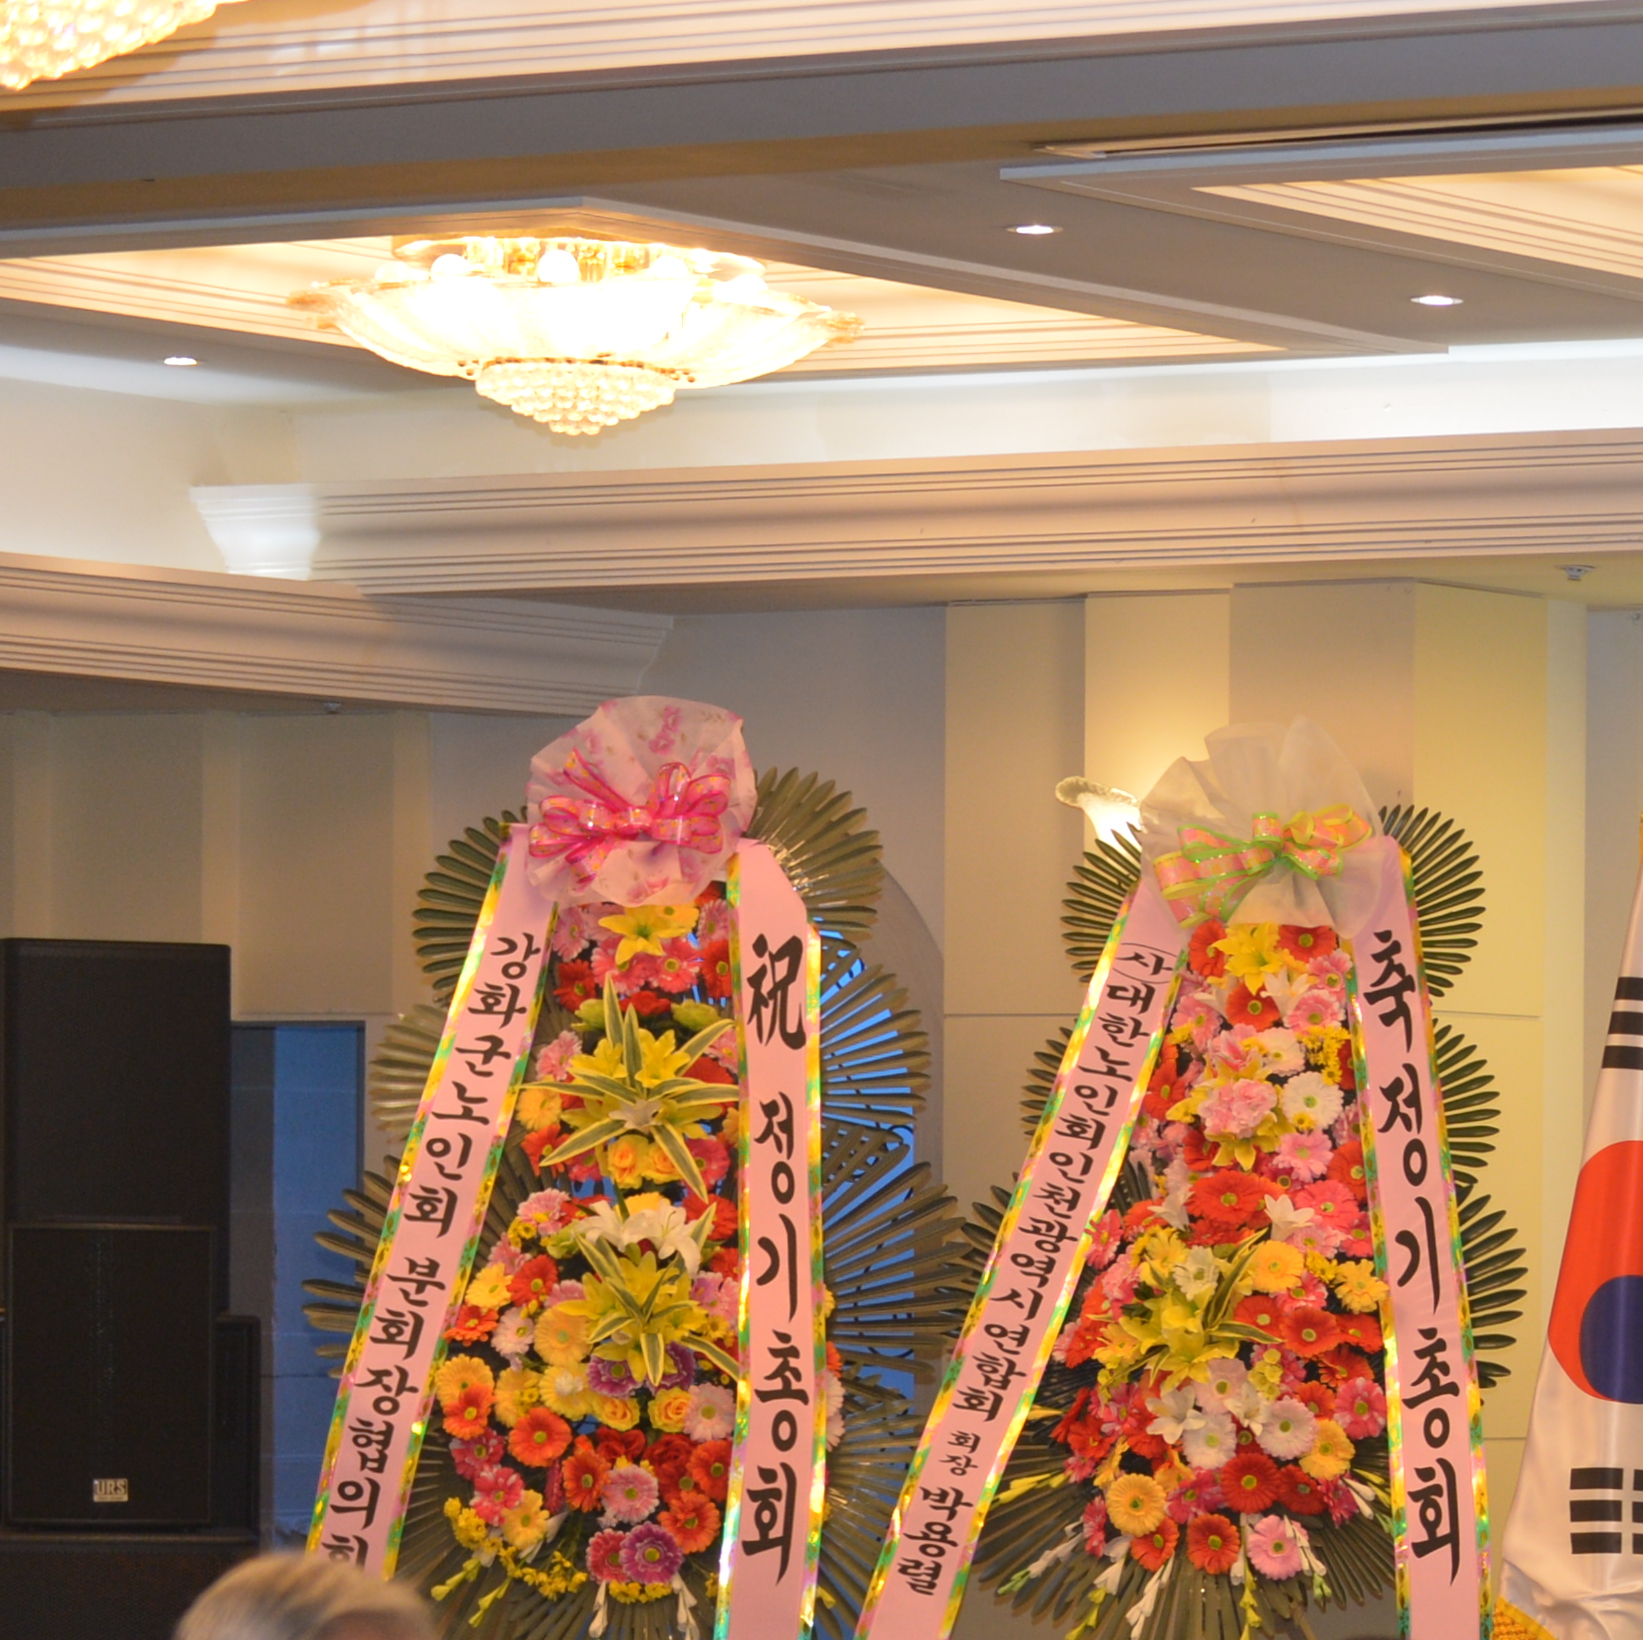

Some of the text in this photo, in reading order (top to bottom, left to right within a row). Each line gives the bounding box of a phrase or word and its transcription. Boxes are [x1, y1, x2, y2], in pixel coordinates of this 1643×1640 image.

[403, 932, 542, 1238] 강화군노인회
[741, 933, 810, 1586] 祝 정기총회
[897, 1486, 975, 1597] 박용렬
[938, 1430, 981, 1477] 회장
